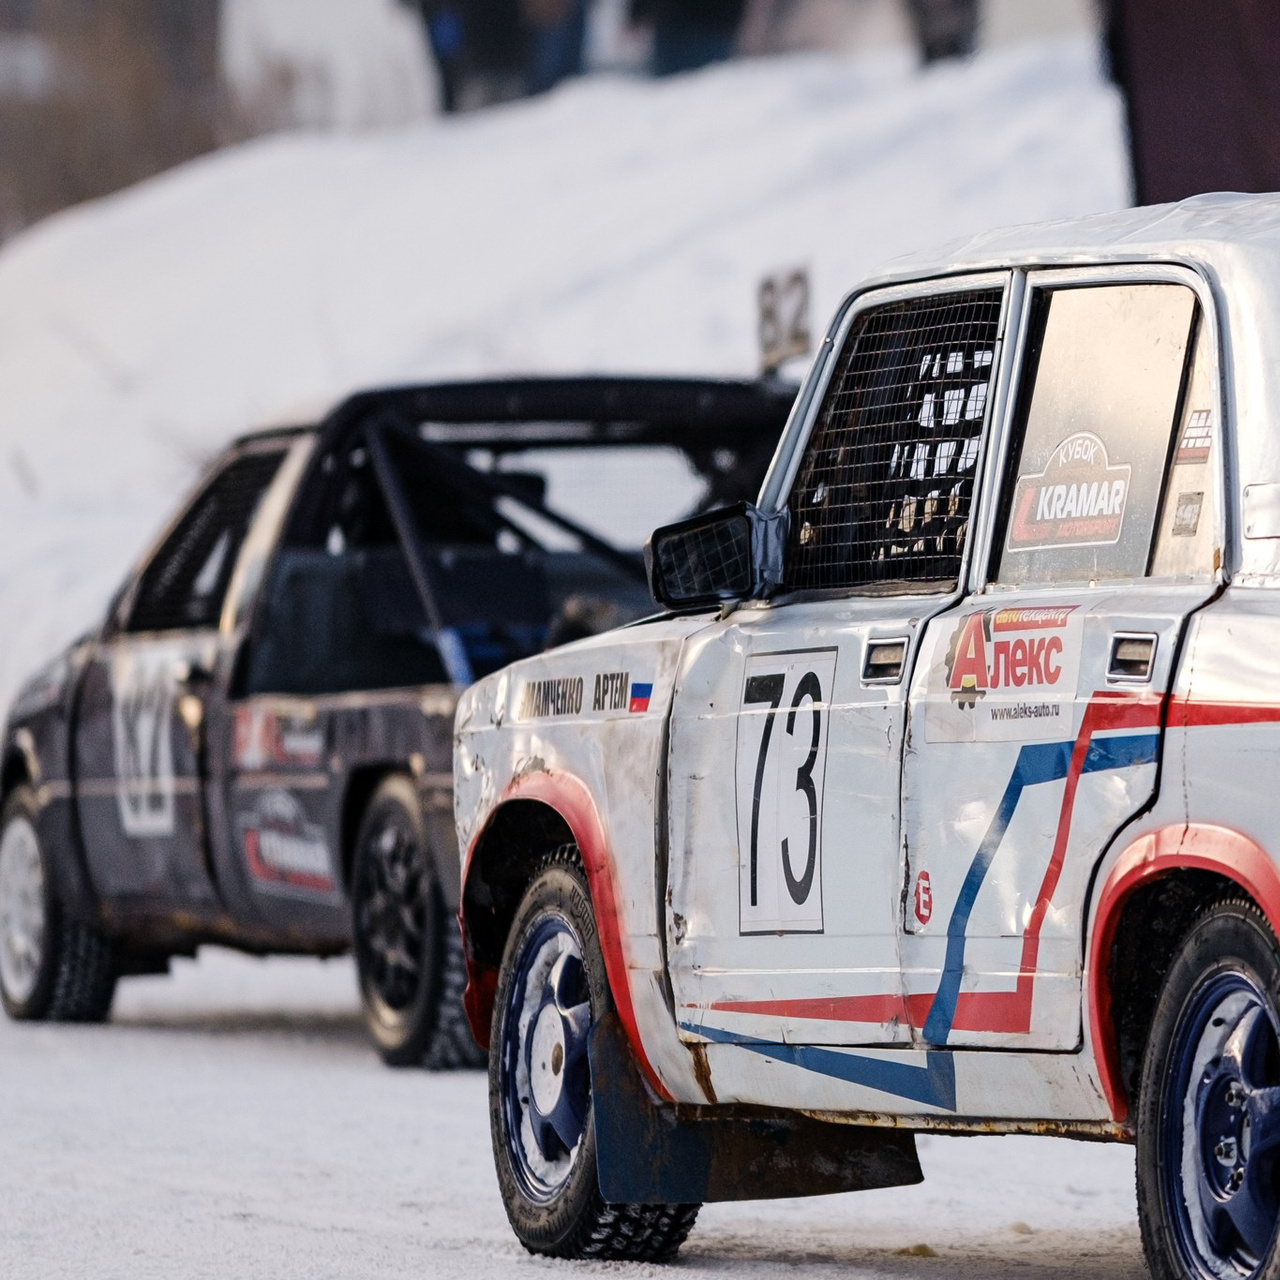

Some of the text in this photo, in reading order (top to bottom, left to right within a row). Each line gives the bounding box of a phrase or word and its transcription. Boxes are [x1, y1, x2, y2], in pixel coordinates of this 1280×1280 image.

[1058, 439, 1098, 468] КУБОК
[1036, 479, 1125, 521] KRAMAR
[950, 612, 1063, 689] Алекс
[593, 672, 629, 712] АРТЕМ
[990, 702, 1060, 721] www.aleks-auto.ru
[744, 671, 822, 907] 73
